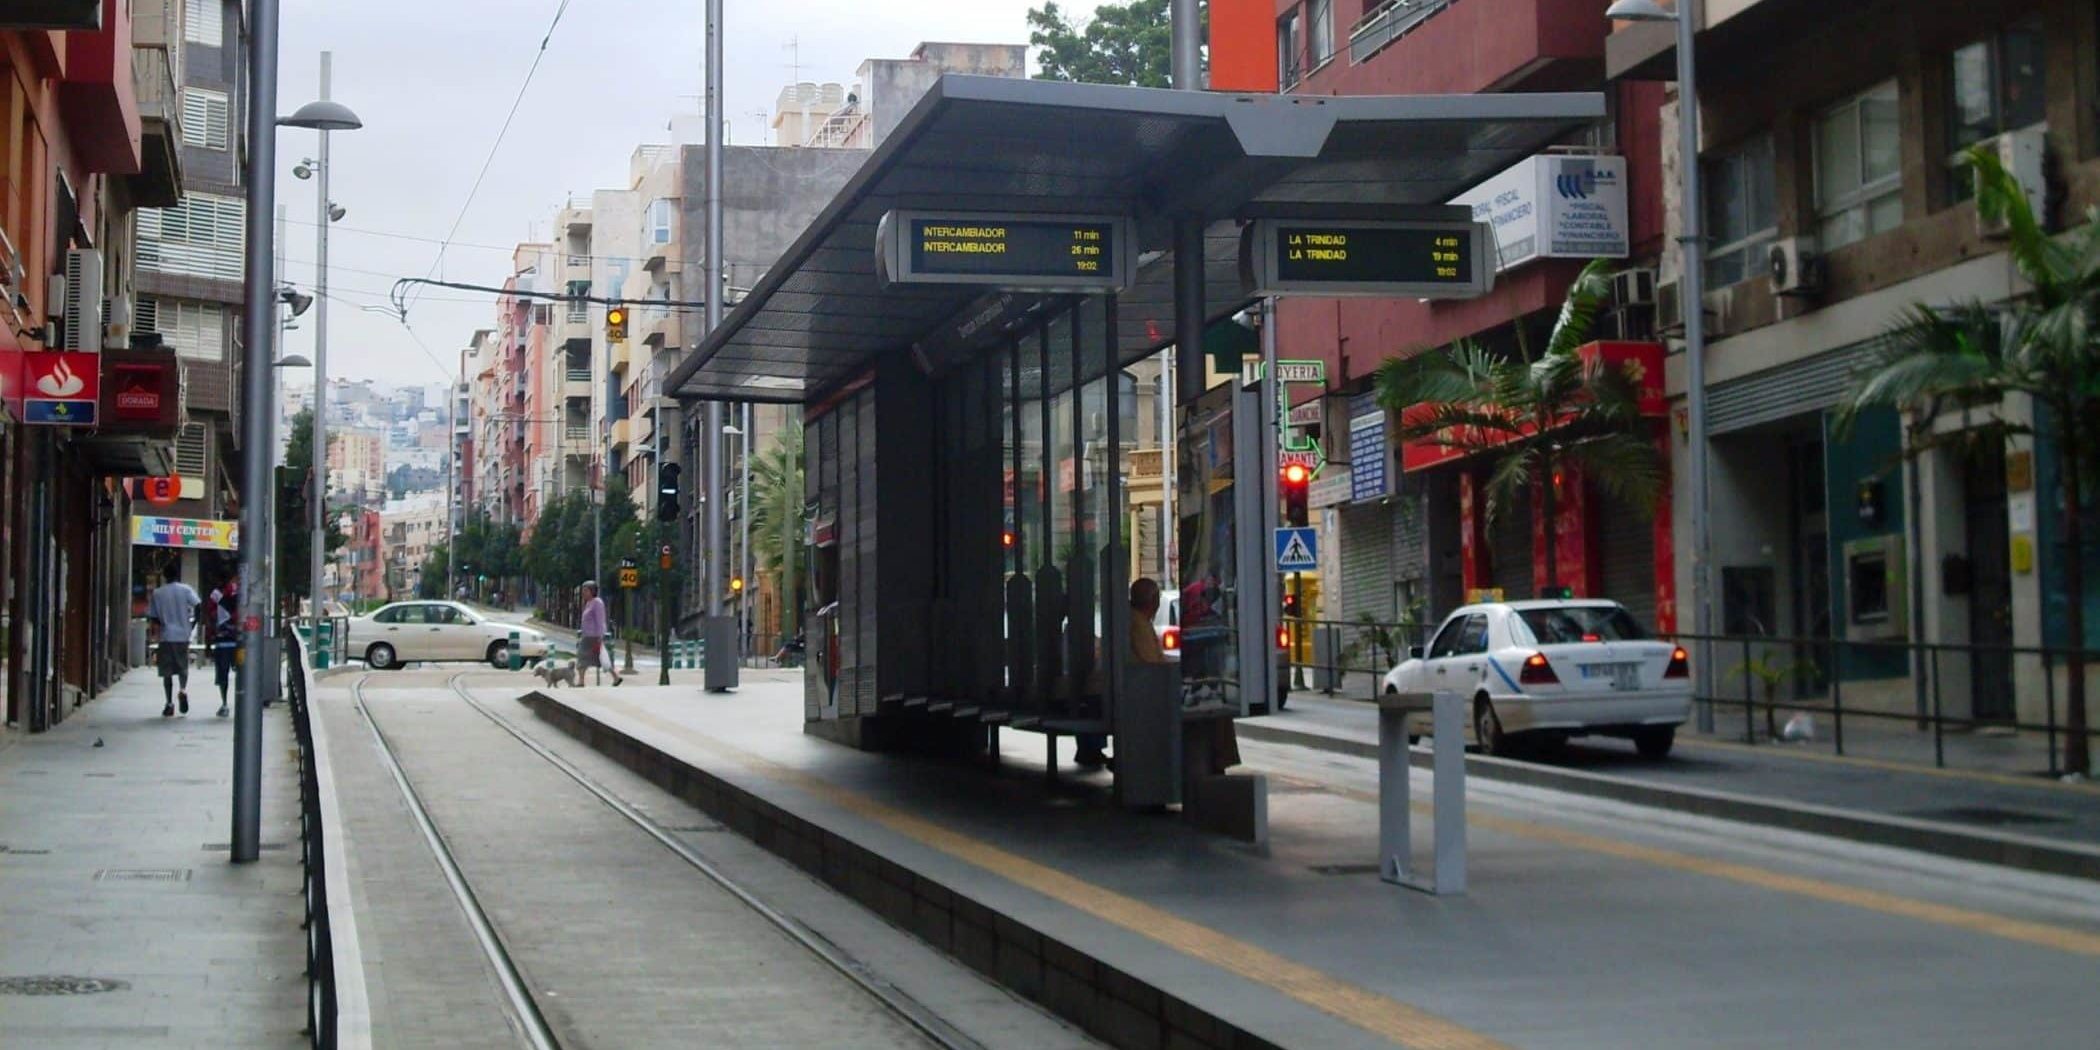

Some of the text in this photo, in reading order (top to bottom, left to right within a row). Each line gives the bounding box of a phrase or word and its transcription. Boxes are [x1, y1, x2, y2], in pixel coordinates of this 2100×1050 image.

[923, 226, 1100, 240] INTERCAMBIADOR 11 min
[1289, 235, 1458, 247] LA TRINIDAD 4 min
[923, 241, 1006, 253] INTERCAMBIADOR
[1083, 246, 1100, 255] min
[1289, 249, 1302, 260] LA
[1306, 250, 1346, 261] TRINIDAD
[1442, 252, 1459, 261] min
[1077, 261, 1097, 271] 19:02
[1276, 366, 1319, 379] OYERIA
[1280, 453, 1317, 467] AMANTE
[622, 573, 636, 582] 40
